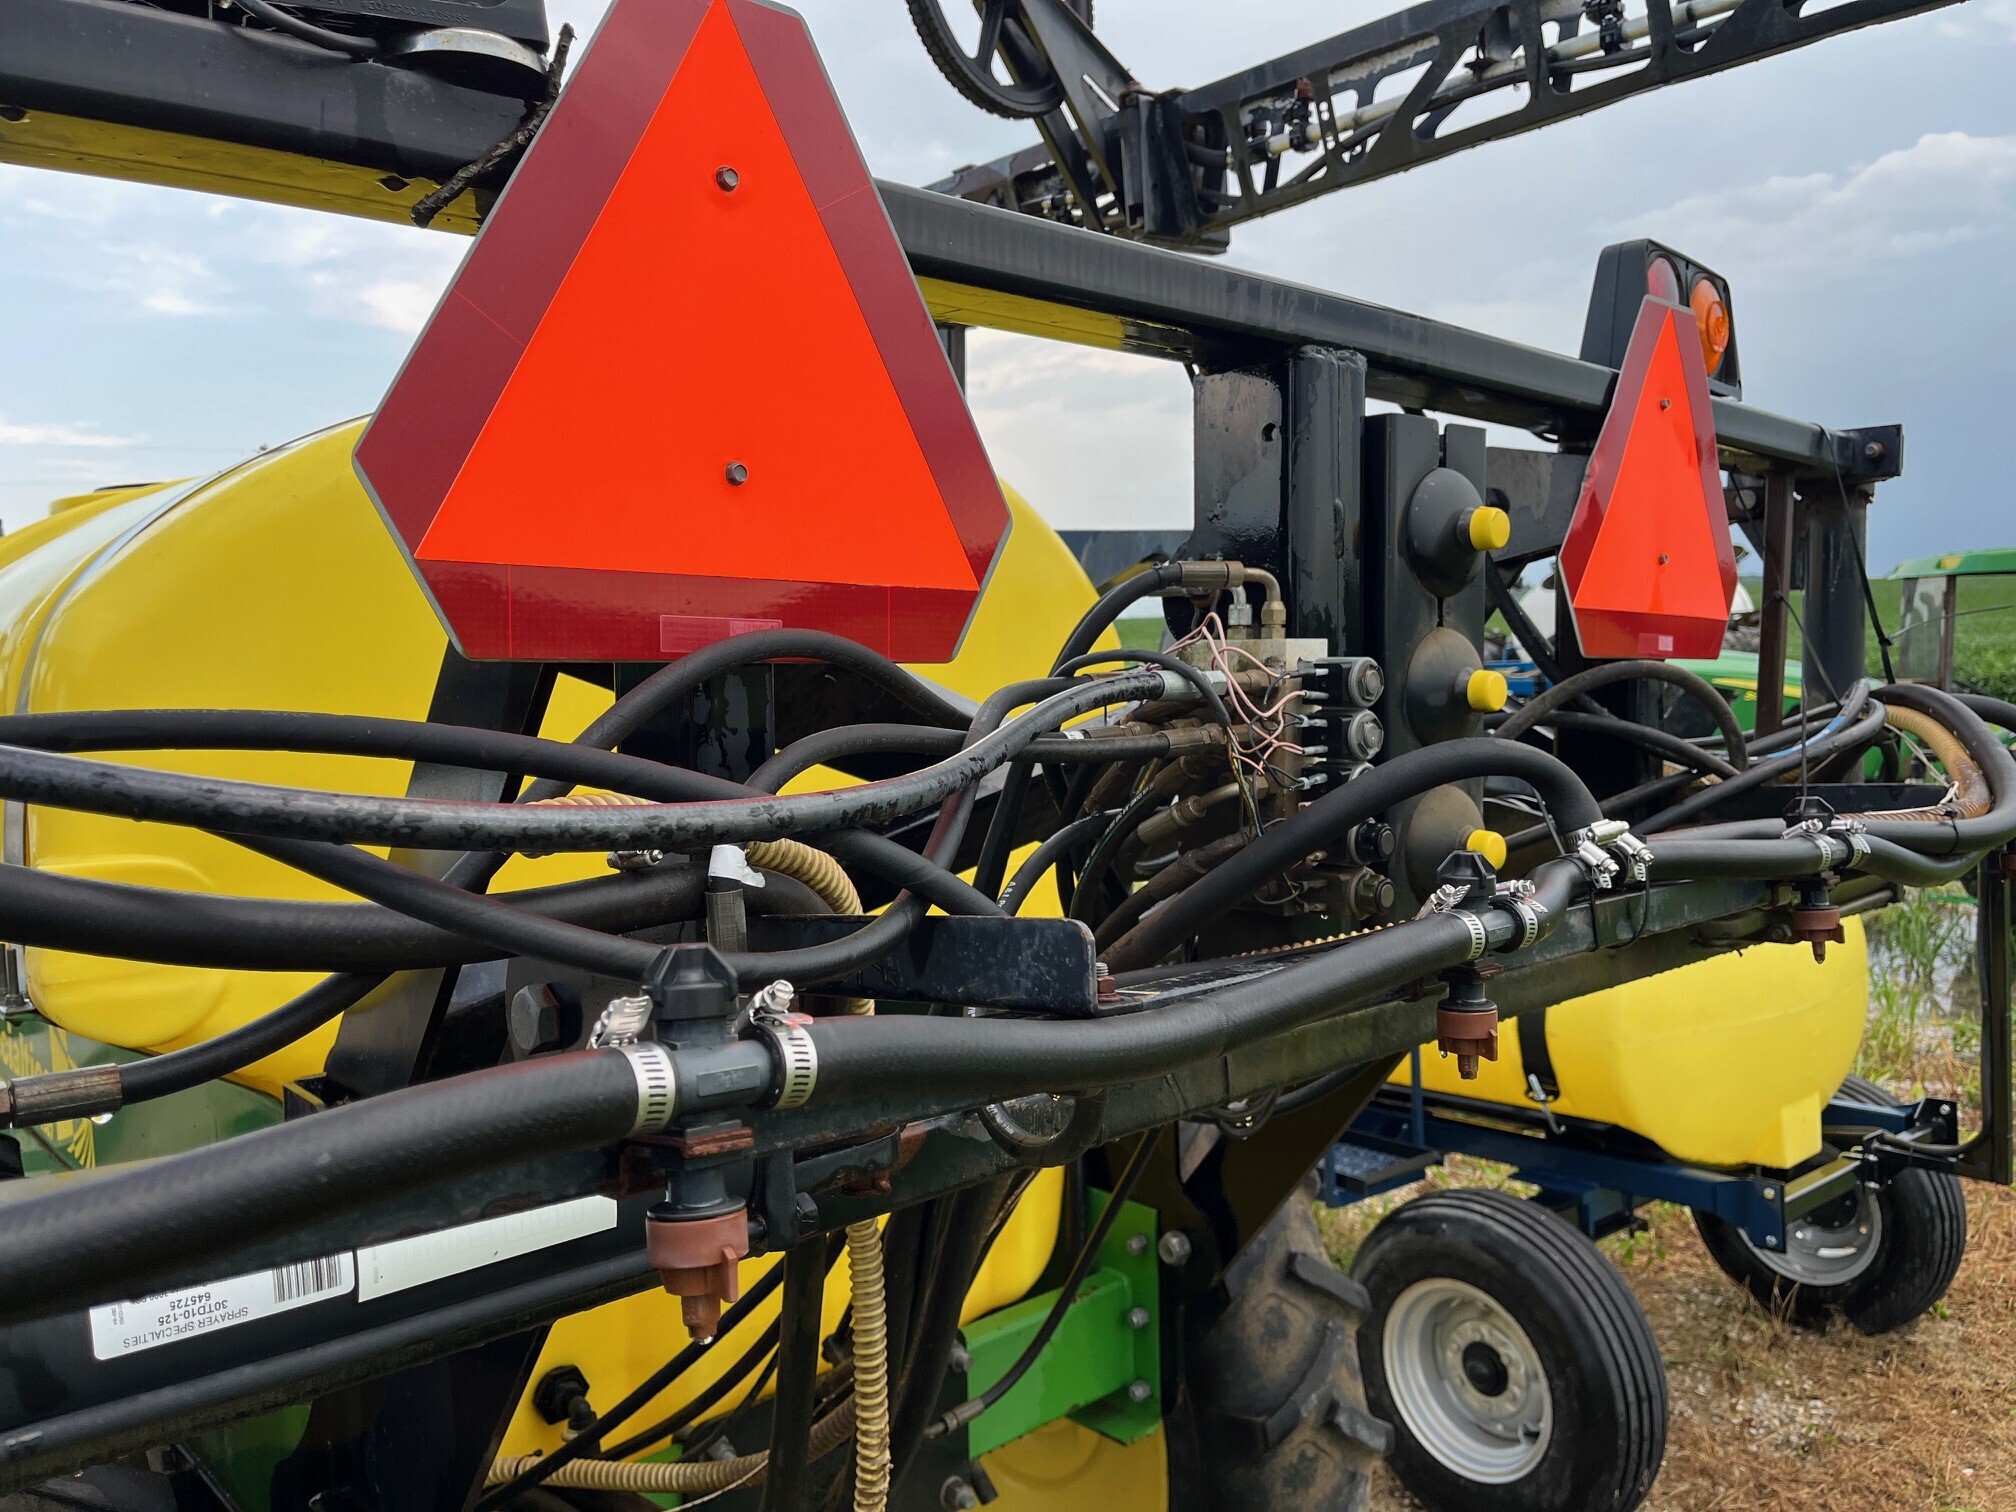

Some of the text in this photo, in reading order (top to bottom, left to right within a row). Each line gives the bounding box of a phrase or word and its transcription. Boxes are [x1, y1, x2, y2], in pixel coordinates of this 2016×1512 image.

[157, 1299, 228, 1326] 30TD10-125
[169, 1292, 211, 1311] 645725
[123, 1306, 249, 1348] SPRAYER SPECIALTIES
